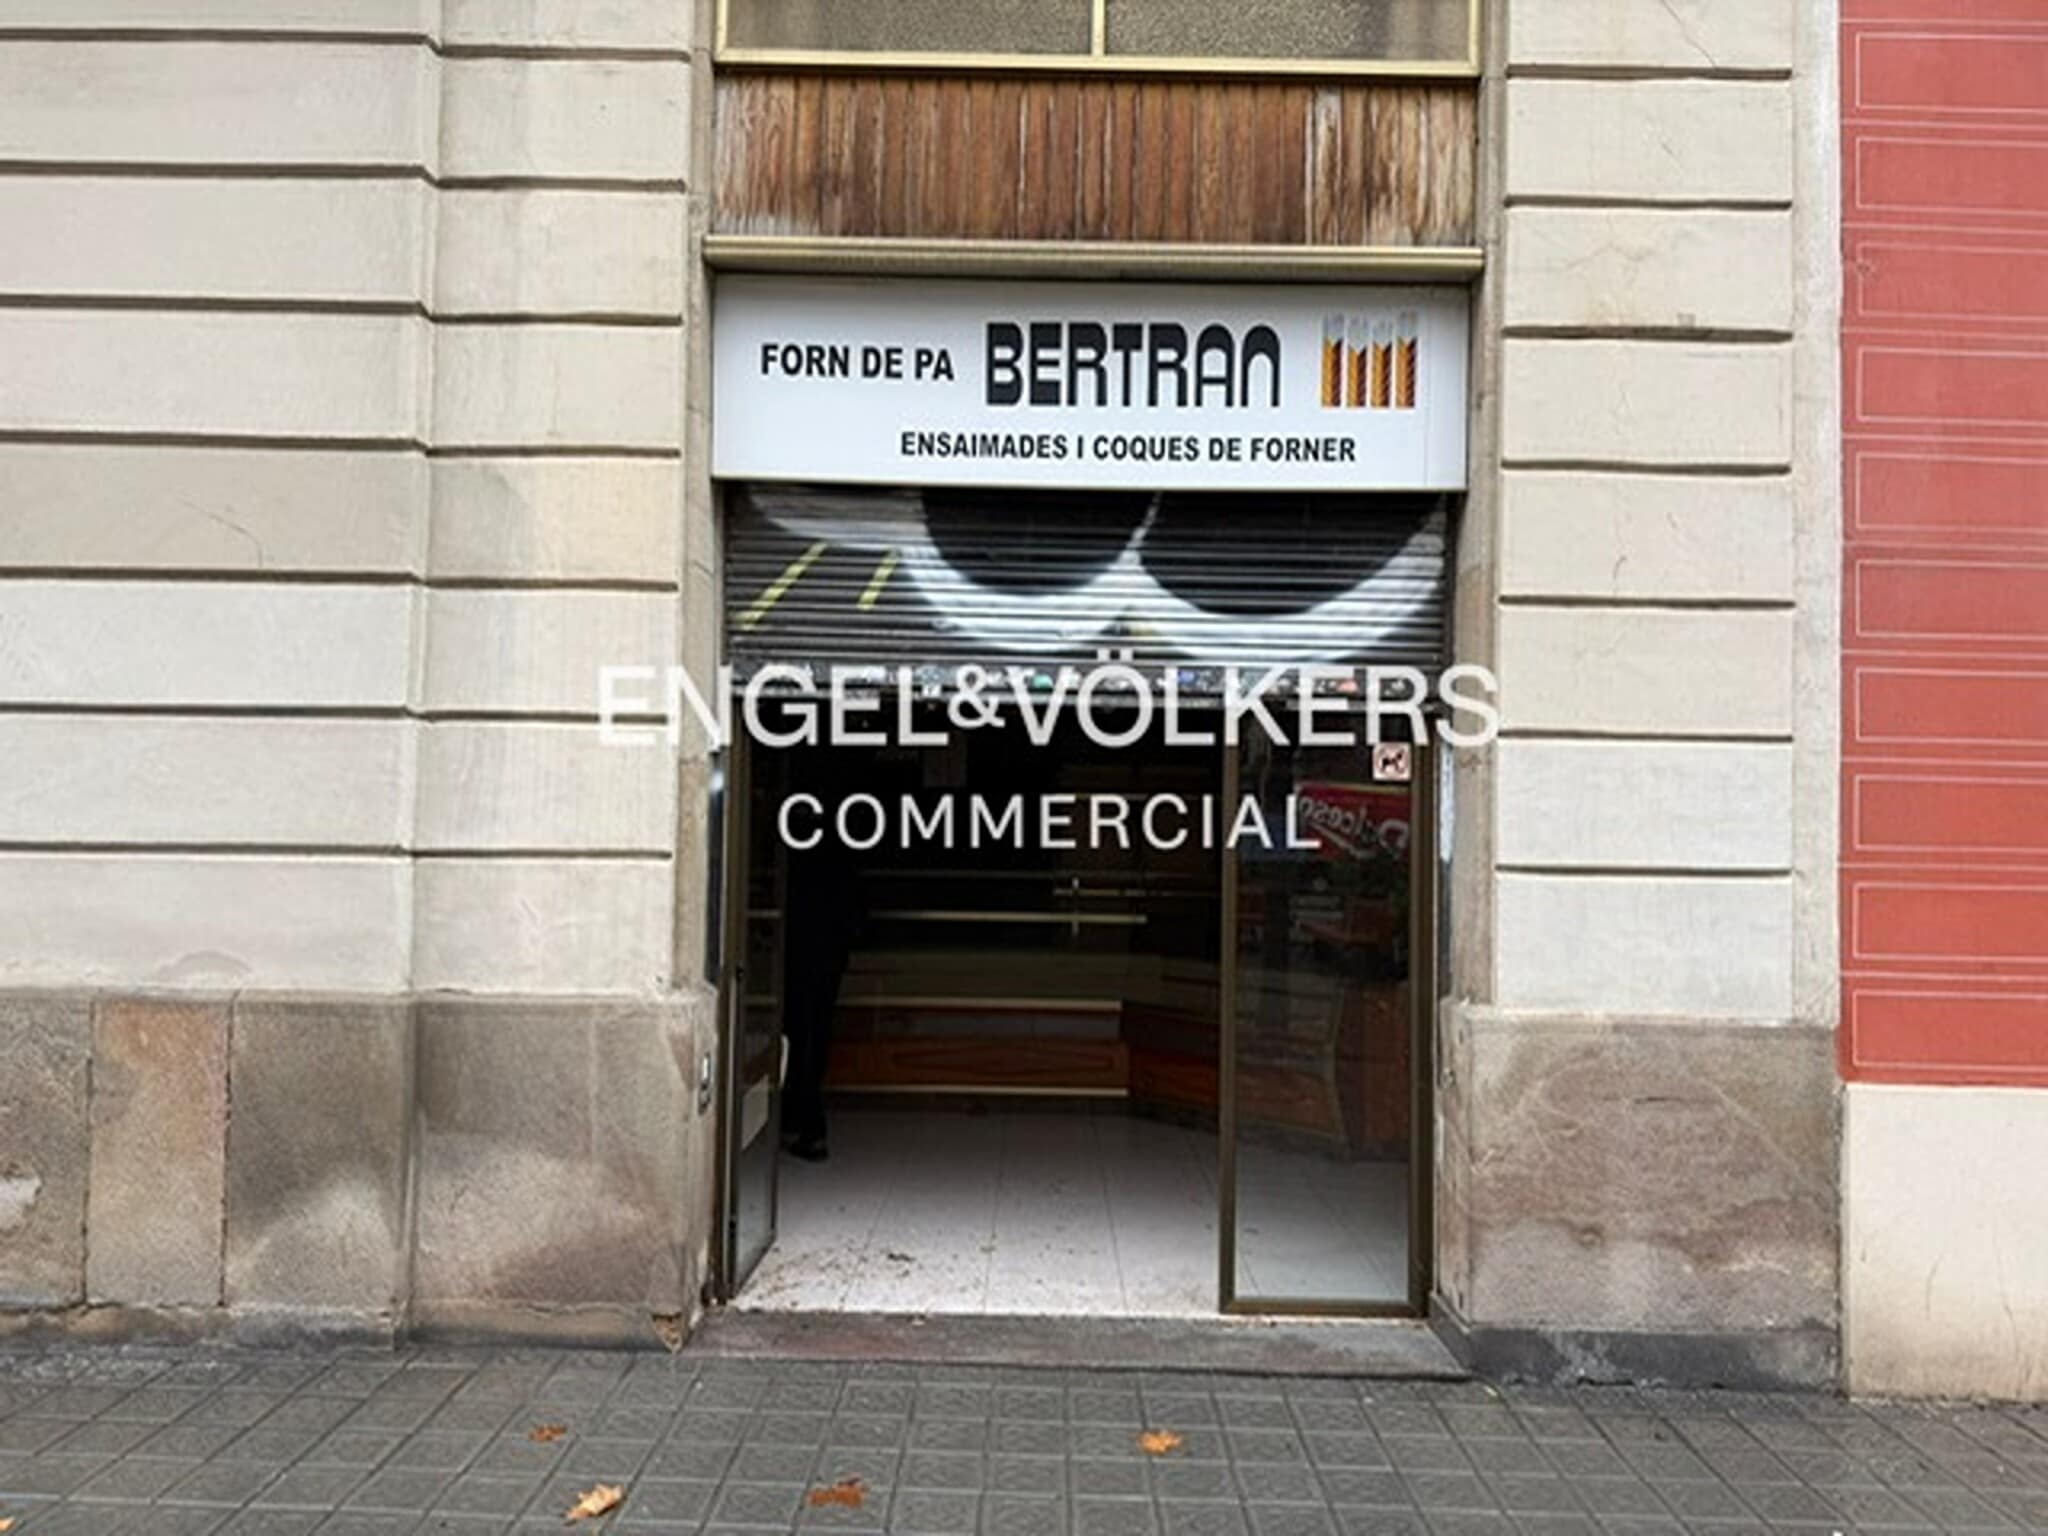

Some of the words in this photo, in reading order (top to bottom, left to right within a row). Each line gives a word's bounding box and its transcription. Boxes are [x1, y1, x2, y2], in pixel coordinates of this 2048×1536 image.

[760, 343, 850, 378] FORN
[861, 346, 903, 379] DE
[915, 348, 955, 381] PA
[985, 321, 1282, 408] BERTRAN
[900, 431, 1068, 460] ENSAIMADES
[1076, 435, 1085, 460] I
[1093, 435, 1200, 463] COQUES
[1209, 437, 1241, 462] DE
[1249, 437, 1356, 463] FORNER
